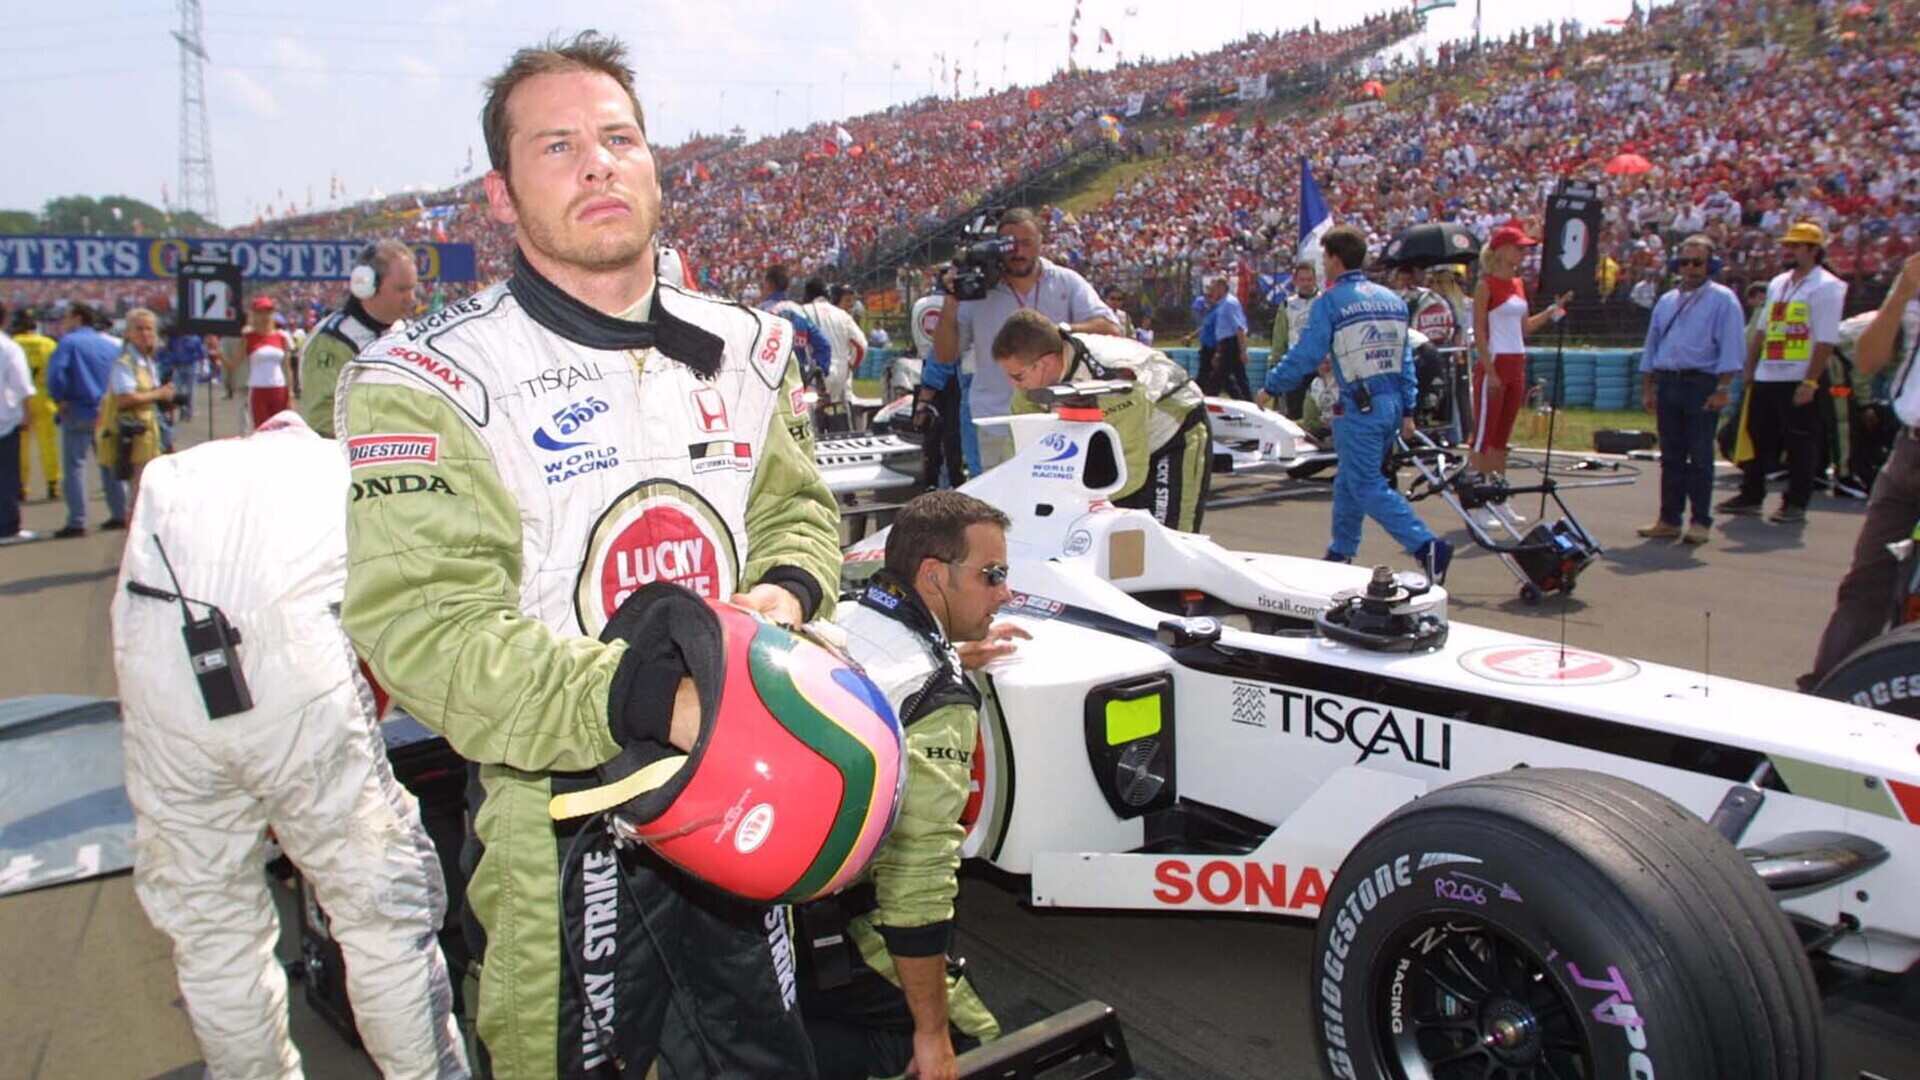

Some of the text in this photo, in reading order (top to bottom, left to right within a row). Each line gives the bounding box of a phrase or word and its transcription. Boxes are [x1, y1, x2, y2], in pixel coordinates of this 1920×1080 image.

[1561, 218, 1588, 270] 9
[189, 280, 236, 320] 12
[407, 298, 482, 341] LUCKIES
[387, 347, 465, 391] SONAX
[520, 362, 604, 398] TISCALI
[552, 396, 610, 435] 555
[544, 446, 618, 473] WORLD
[546, 457, 620, 485] RACING
[617, 537, 704, 587] LUCKY
[1269, 688, 1451, 771] TISCALI
[583, 848, 617, 961] STRIKE
[1153, 860, 1337, 909] SONA
[1391, 958, 1411, 1035] RACING
